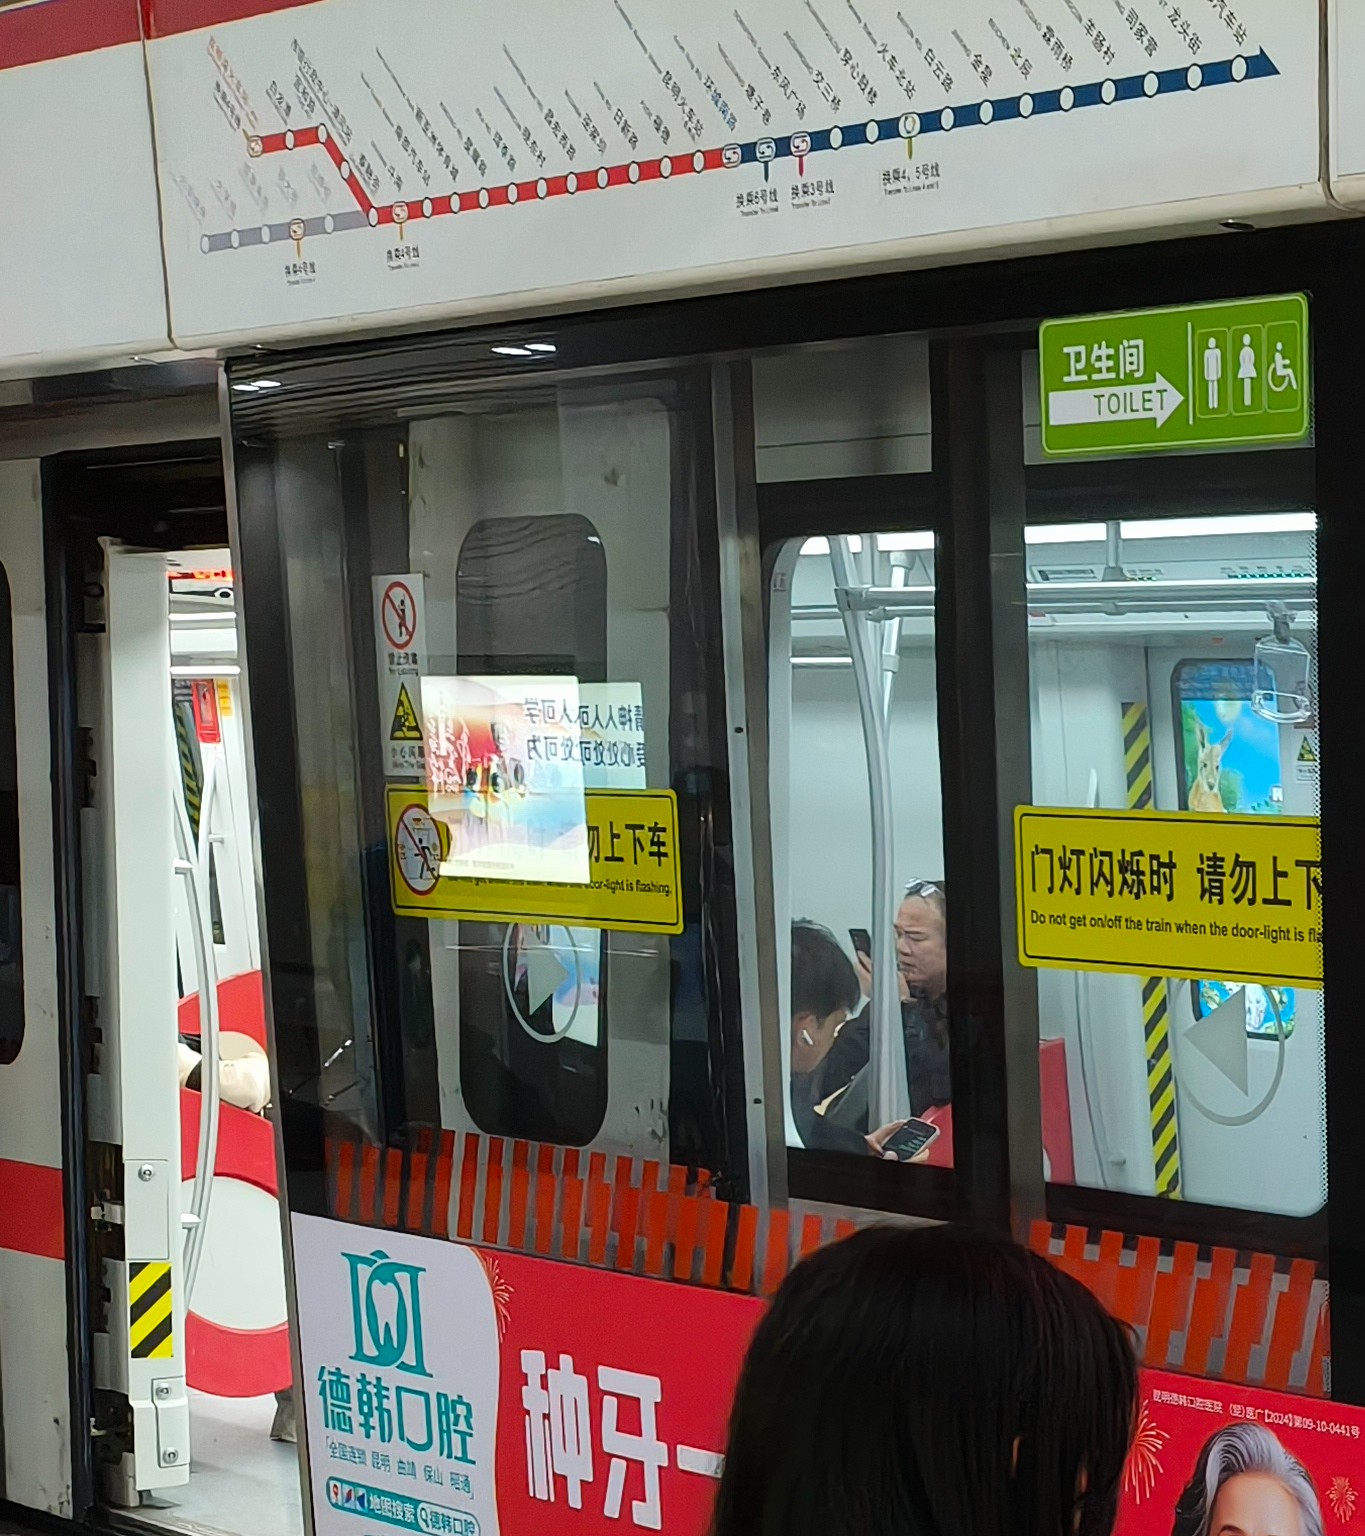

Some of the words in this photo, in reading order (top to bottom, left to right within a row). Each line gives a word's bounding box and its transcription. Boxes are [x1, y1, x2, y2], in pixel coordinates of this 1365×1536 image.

[1063, 338, 1145, 383] 卫生间
[1093, 388, 1169, 416] TOILET
[590, 878, 625, 898] oor-light
[1030, 843, 1177, 903] 门灯闪烁时
[1030, 908, 1047, 925] Do
[1048, 913, 1068, 927] not
[1069, 914, 1087, 930] get
[1089, 914, 1123, 930] on/off
[1125, 916, 1143, 931] the
[1146, 917, 1173, 933] train
[1175, 919, 1207, 935] when
[1209, 920, 1229, 937] the
[1231, 922, 1292, 944] door-light
[1294, 926, 1305, 942] is
[317, 1365, 477, 1467] 德韩口腔
